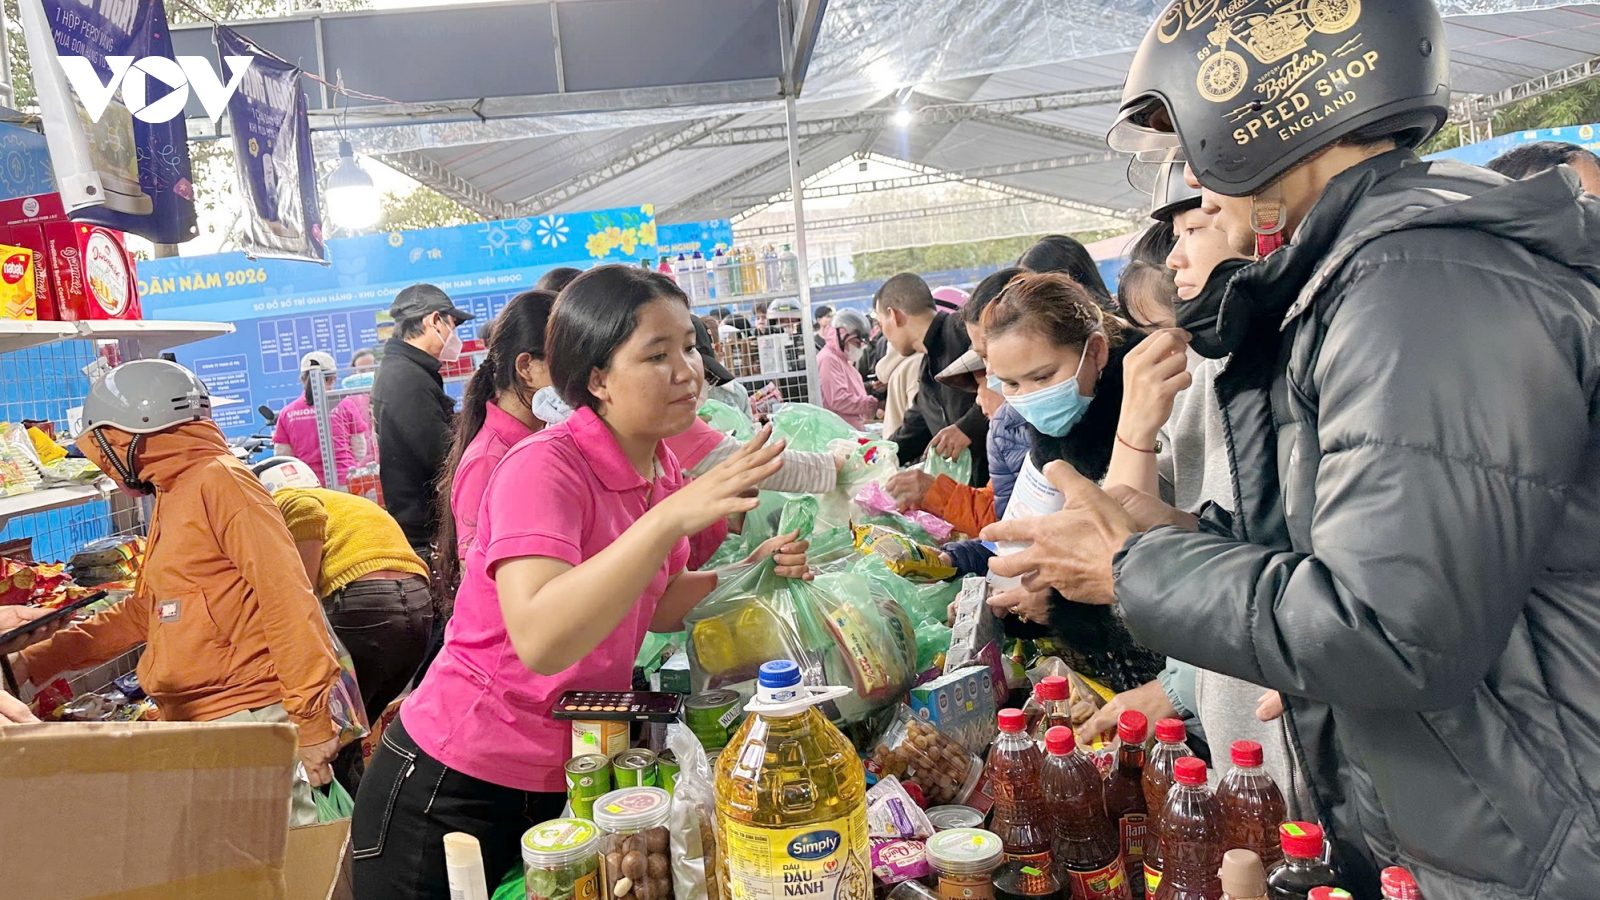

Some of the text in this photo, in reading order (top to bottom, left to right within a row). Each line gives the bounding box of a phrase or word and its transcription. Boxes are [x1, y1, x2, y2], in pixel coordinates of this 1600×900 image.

[54, 29, 70, 48] MUA
[56, 8, 61, 22] 1
[62, 10, 81, 32] HỘP
[80, 20, 100, 43] PEPSI
[1253, 50, 1327, 103] Bobbers
[1232, 50, 1379, 145] SPEED SHOP
[1278, 90, 1357, 141] ENGLAND
[179, 271, 222, 292] NĂM
[224, 267, 267, 287] 2026
[307, 295, 327, 305] GIAN
[329, 292, 352, 302] HÀNG
[359, 290, 375, 299] KHU
[377, 285, 401, 297] CÔNG
[453, 279, 472, 289] NAM
[1125, 824, 1148, 838] Nam
[793, 836, 838, 855] Simply
